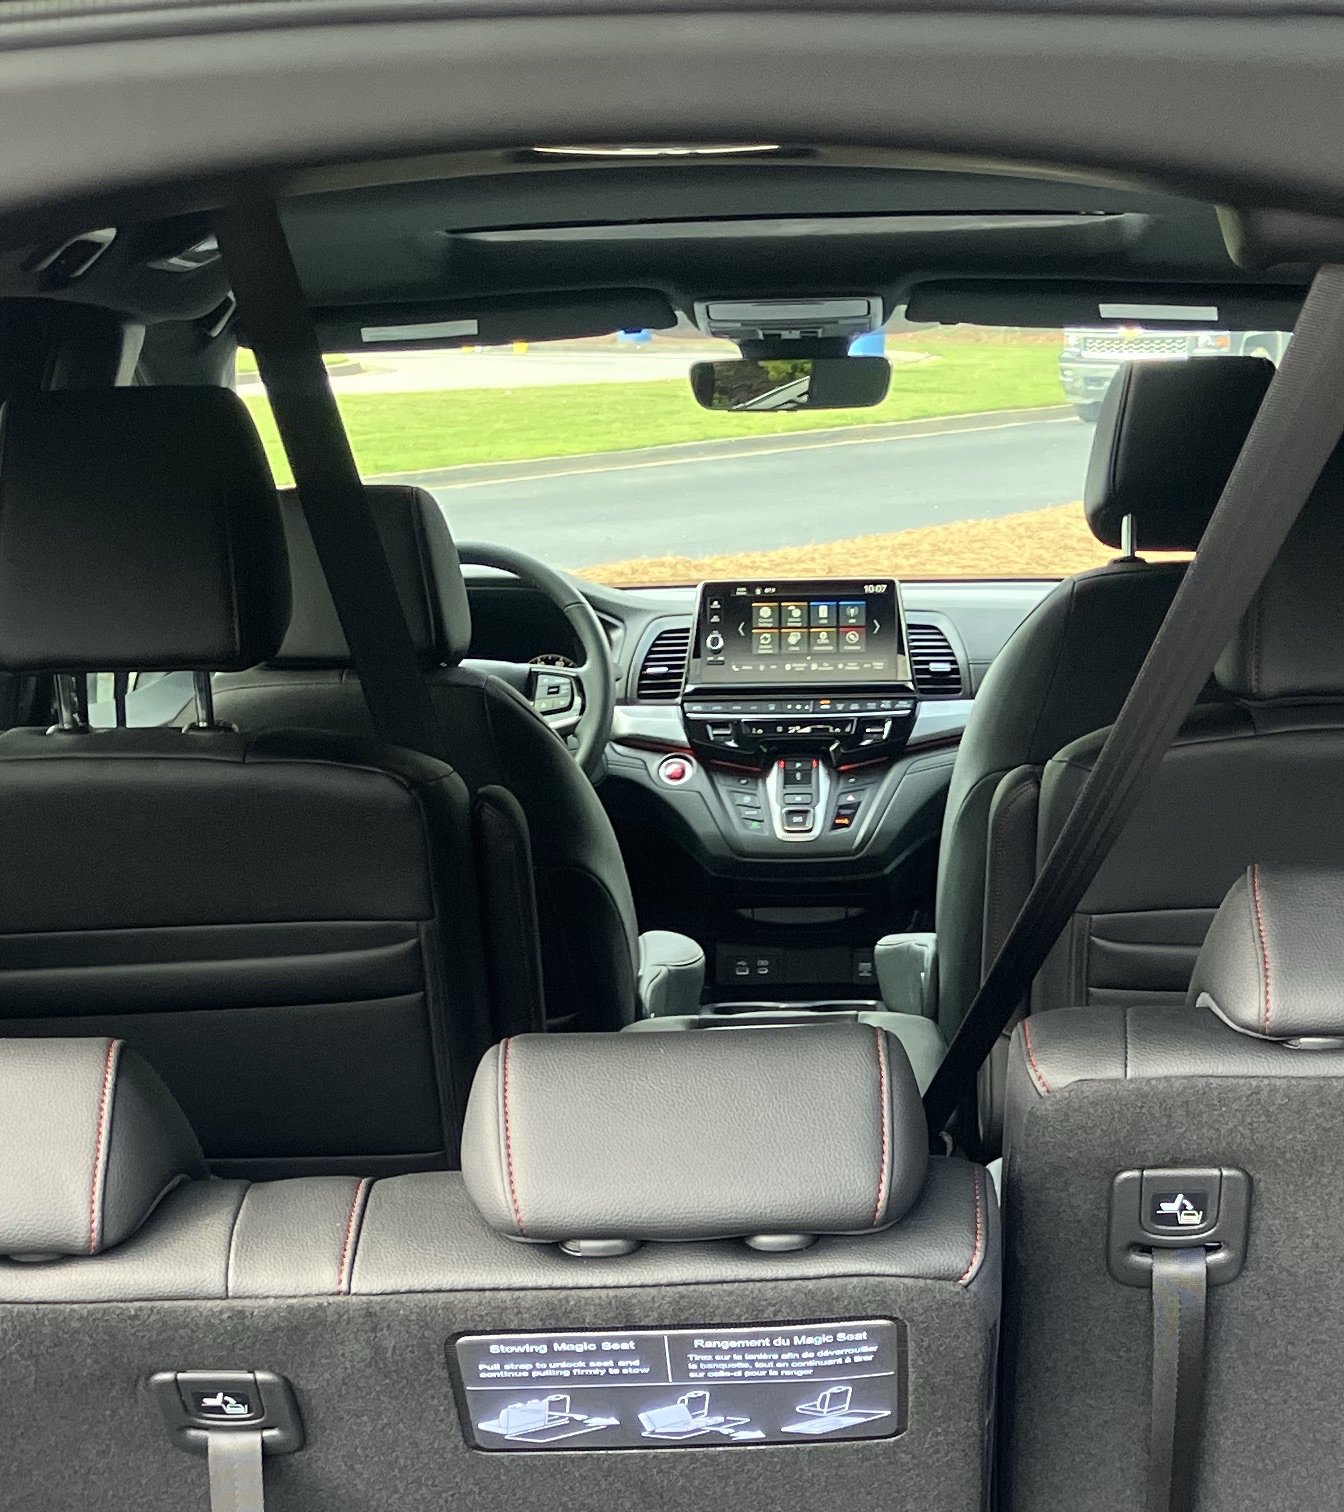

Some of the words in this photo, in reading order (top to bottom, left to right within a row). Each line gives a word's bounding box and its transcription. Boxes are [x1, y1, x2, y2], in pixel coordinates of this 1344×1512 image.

[693, 1337, 771, 1350] Rangement
[773, 1337, 790, 1347] du
[793, 1335, 834, 1346] Magic
[836, 1331, 868, 1342] Seat
[490, 1344, 548, 1354] Stowing
[553, 1342, 597, 1353] Magic
[602, 1341, 636, 1351] Seat
[687, 1354, 713, 1362] Tirez
[733, 1353, 743, 1361] la
[781, 1352, 800, 1360] afin
[802, 1350, 815, 1359] de
[688, 1362, 698, 1370] la
[791, 1358, 843, 1368] continuant
[854, 1354, 875, 1363] tirer
[478, 1363, 501, 1372] Pull
[504, 1363, 533, 1372] strap
[549, 1360, 586, 1369] unlock
[589, 1360, 614, 1368] seat
[618, 1359, 641, 1367] and
[479, 1370, 529, 1379] continue
[532, 1369, 571, 1378] pulling
[573, 1368, 607, 1377] firmly
[622, 1367, 650, 1375] stow
[744, 1370, 767, 1378] pour
[780, 1369, 814, 1377] ranger
